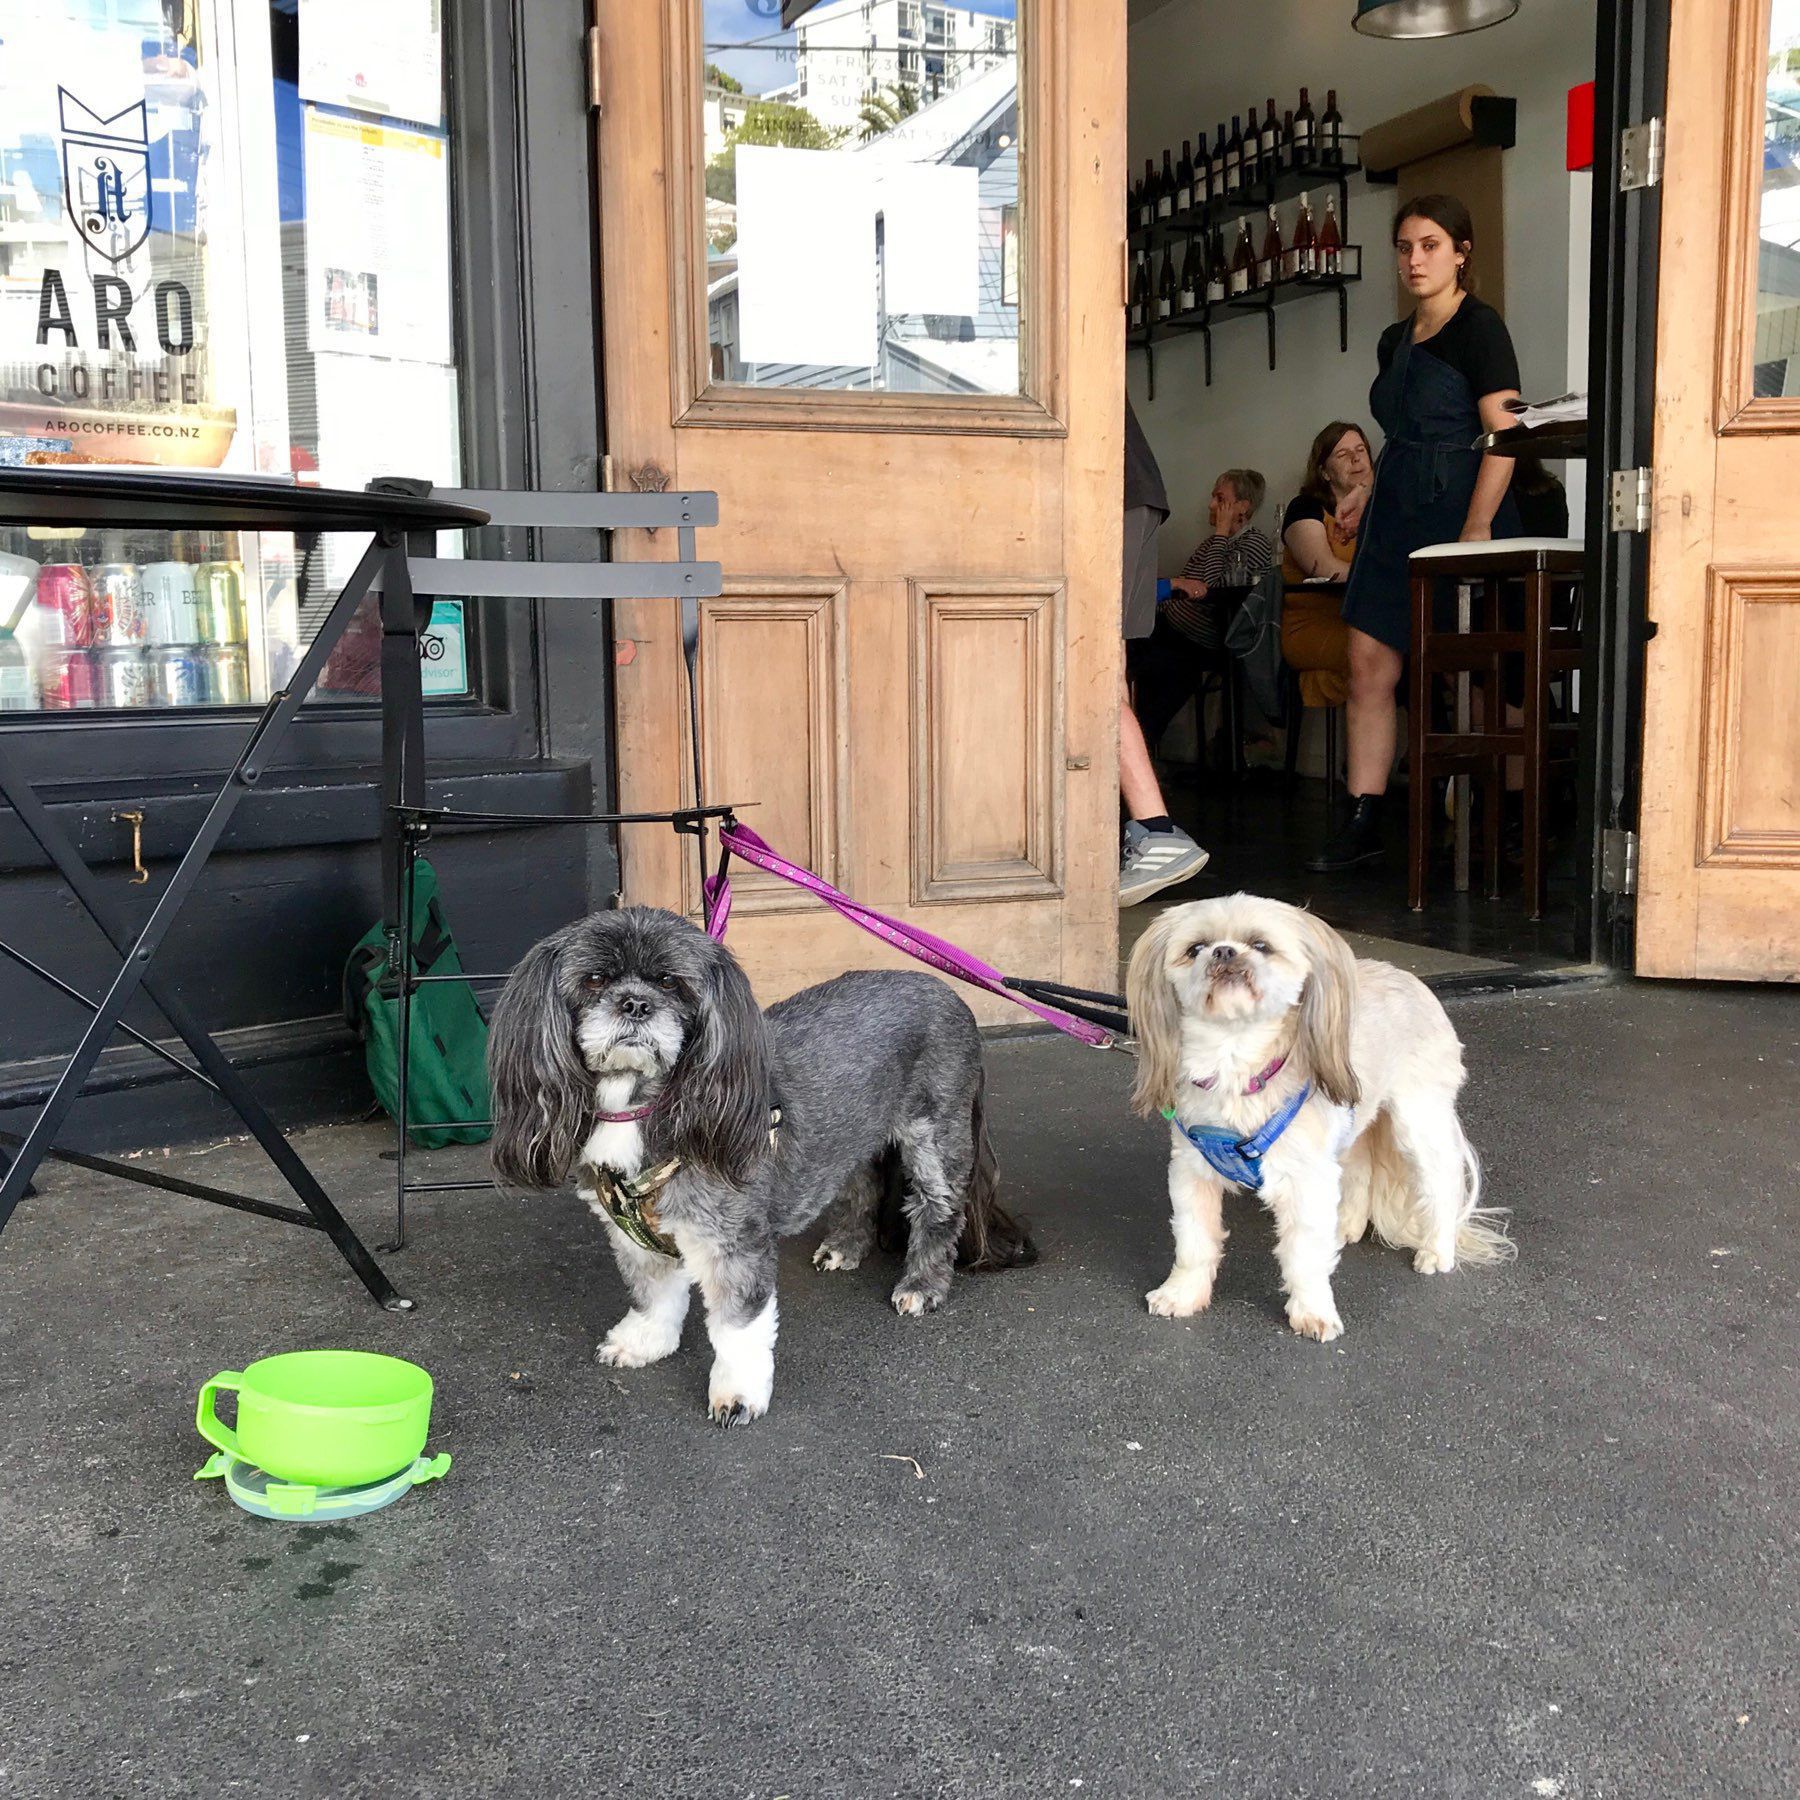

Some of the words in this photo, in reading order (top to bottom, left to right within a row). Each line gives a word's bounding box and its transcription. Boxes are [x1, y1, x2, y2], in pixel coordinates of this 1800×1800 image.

[818, 73, 847, 87] SAT
[36, 268, 194, 357] ARO
[37, 363, 198, 405] COFFEE
[45, 420, 201, 439] AROCOFFEE.CO.NZ
[421, 666, 456, 678] dvisor
